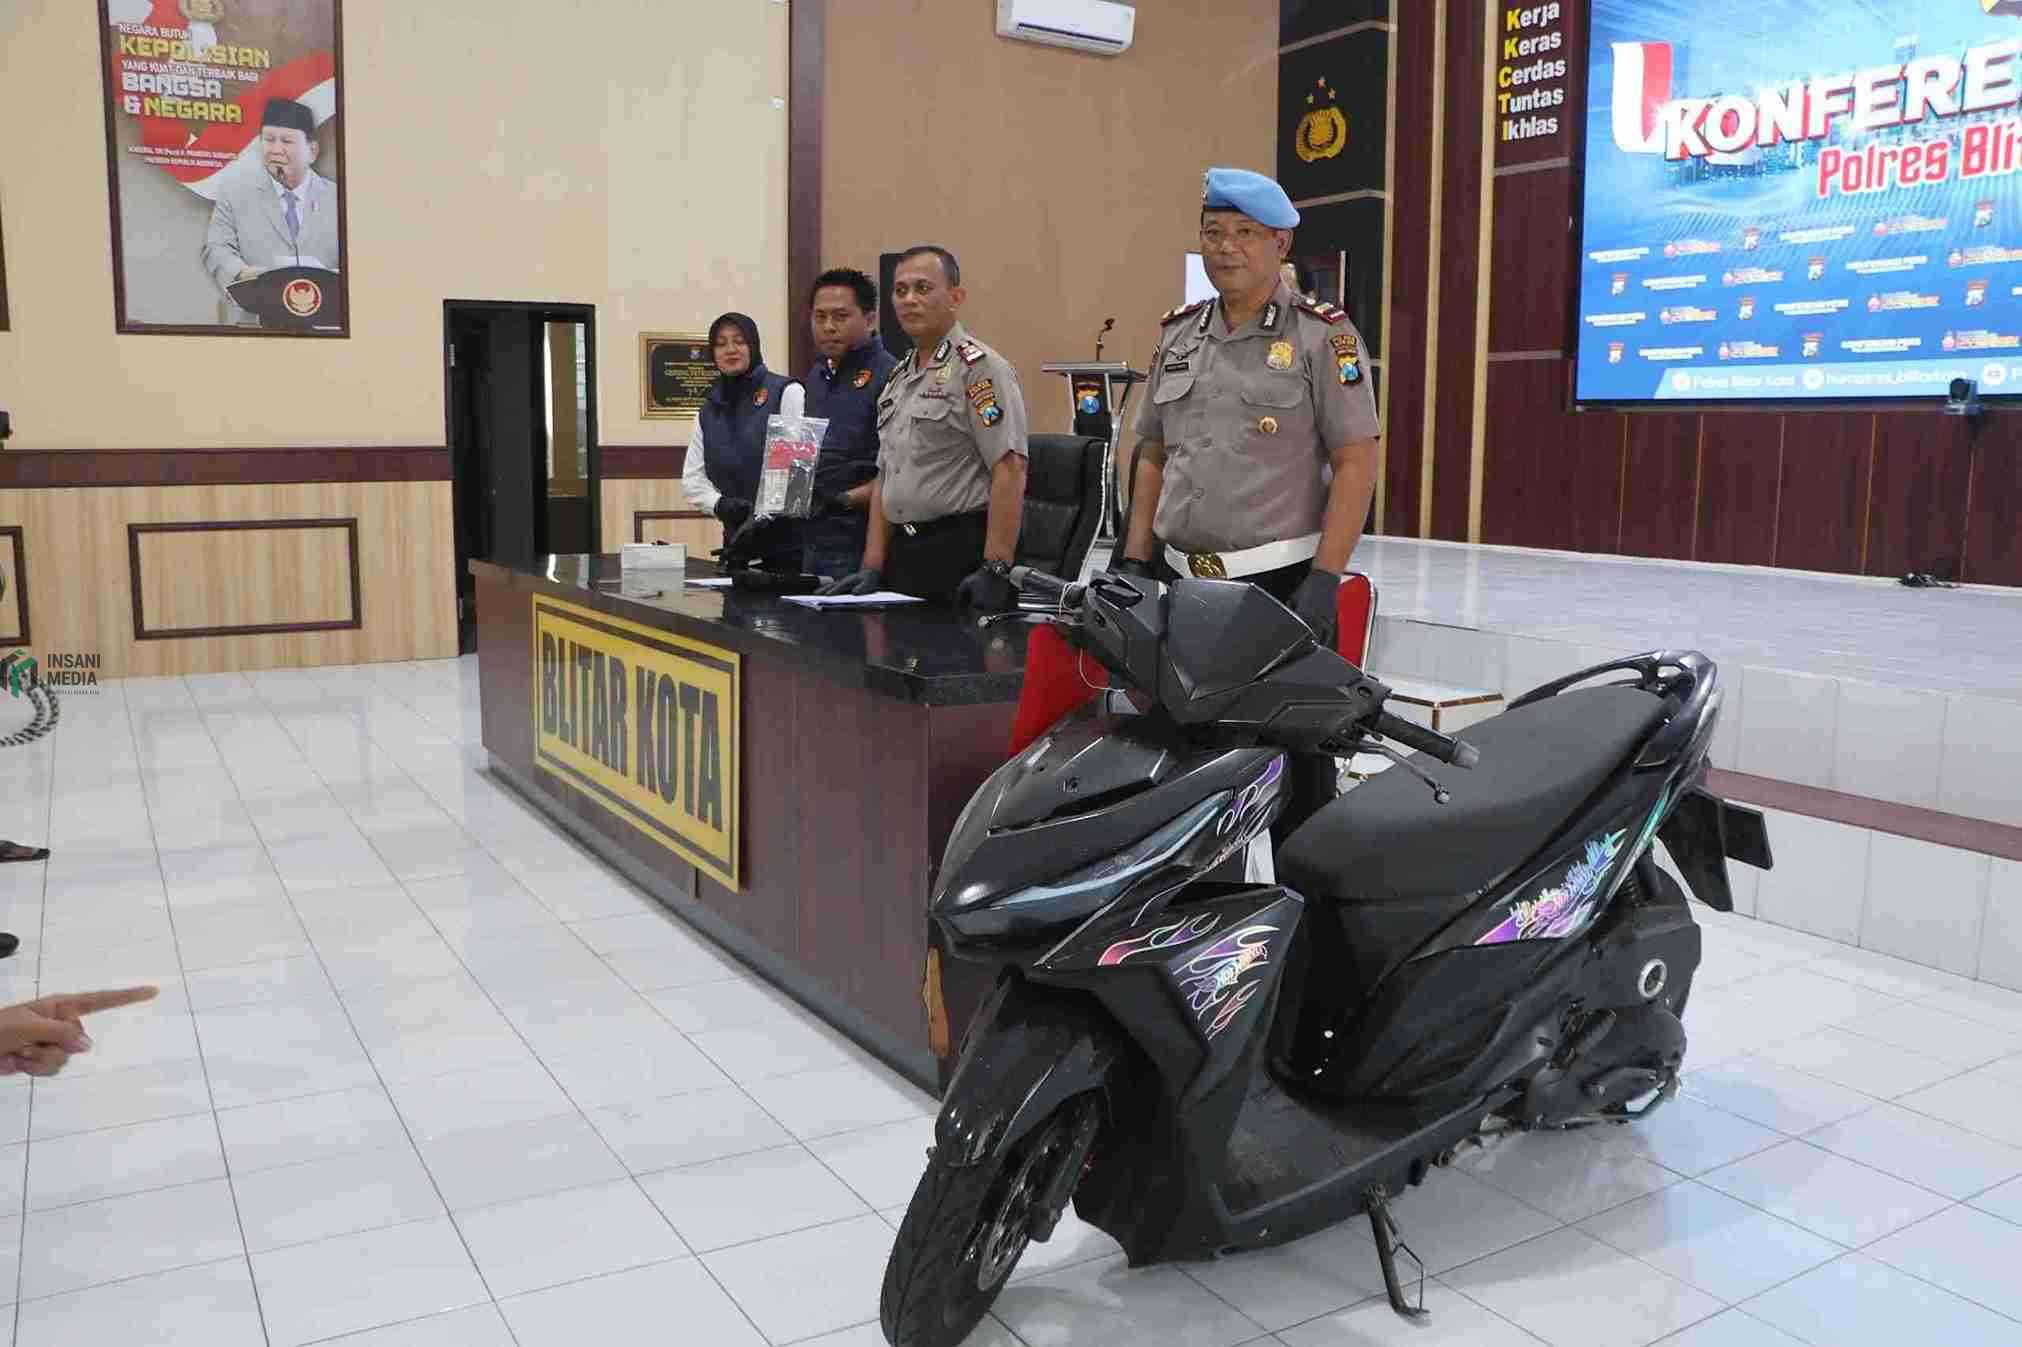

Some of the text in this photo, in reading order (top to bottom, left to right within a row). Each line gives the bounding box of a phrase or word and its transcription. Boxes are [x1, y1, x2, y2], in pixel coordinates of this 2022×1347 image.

[1506, 1, 1560, 31] Kerja
[120, 34, 270, 68] KEPOLSIAN
[1504, 31, 1562, 60] Keras
[122, 72, 222, 98] BANGSA
[1498, 59, 1566, 88] Cerdas
[143, 97, 243, 123] NEGARA
[1498, 88, 1564, 114] Tuntas
[1661, 39, 2022, 161] KONFERE
[1502, 116, 1559, 141] Ikhlas
[1817, 139, 1950, 198] Polres
[542, 630, 724, 834] BLITAR KOTA
